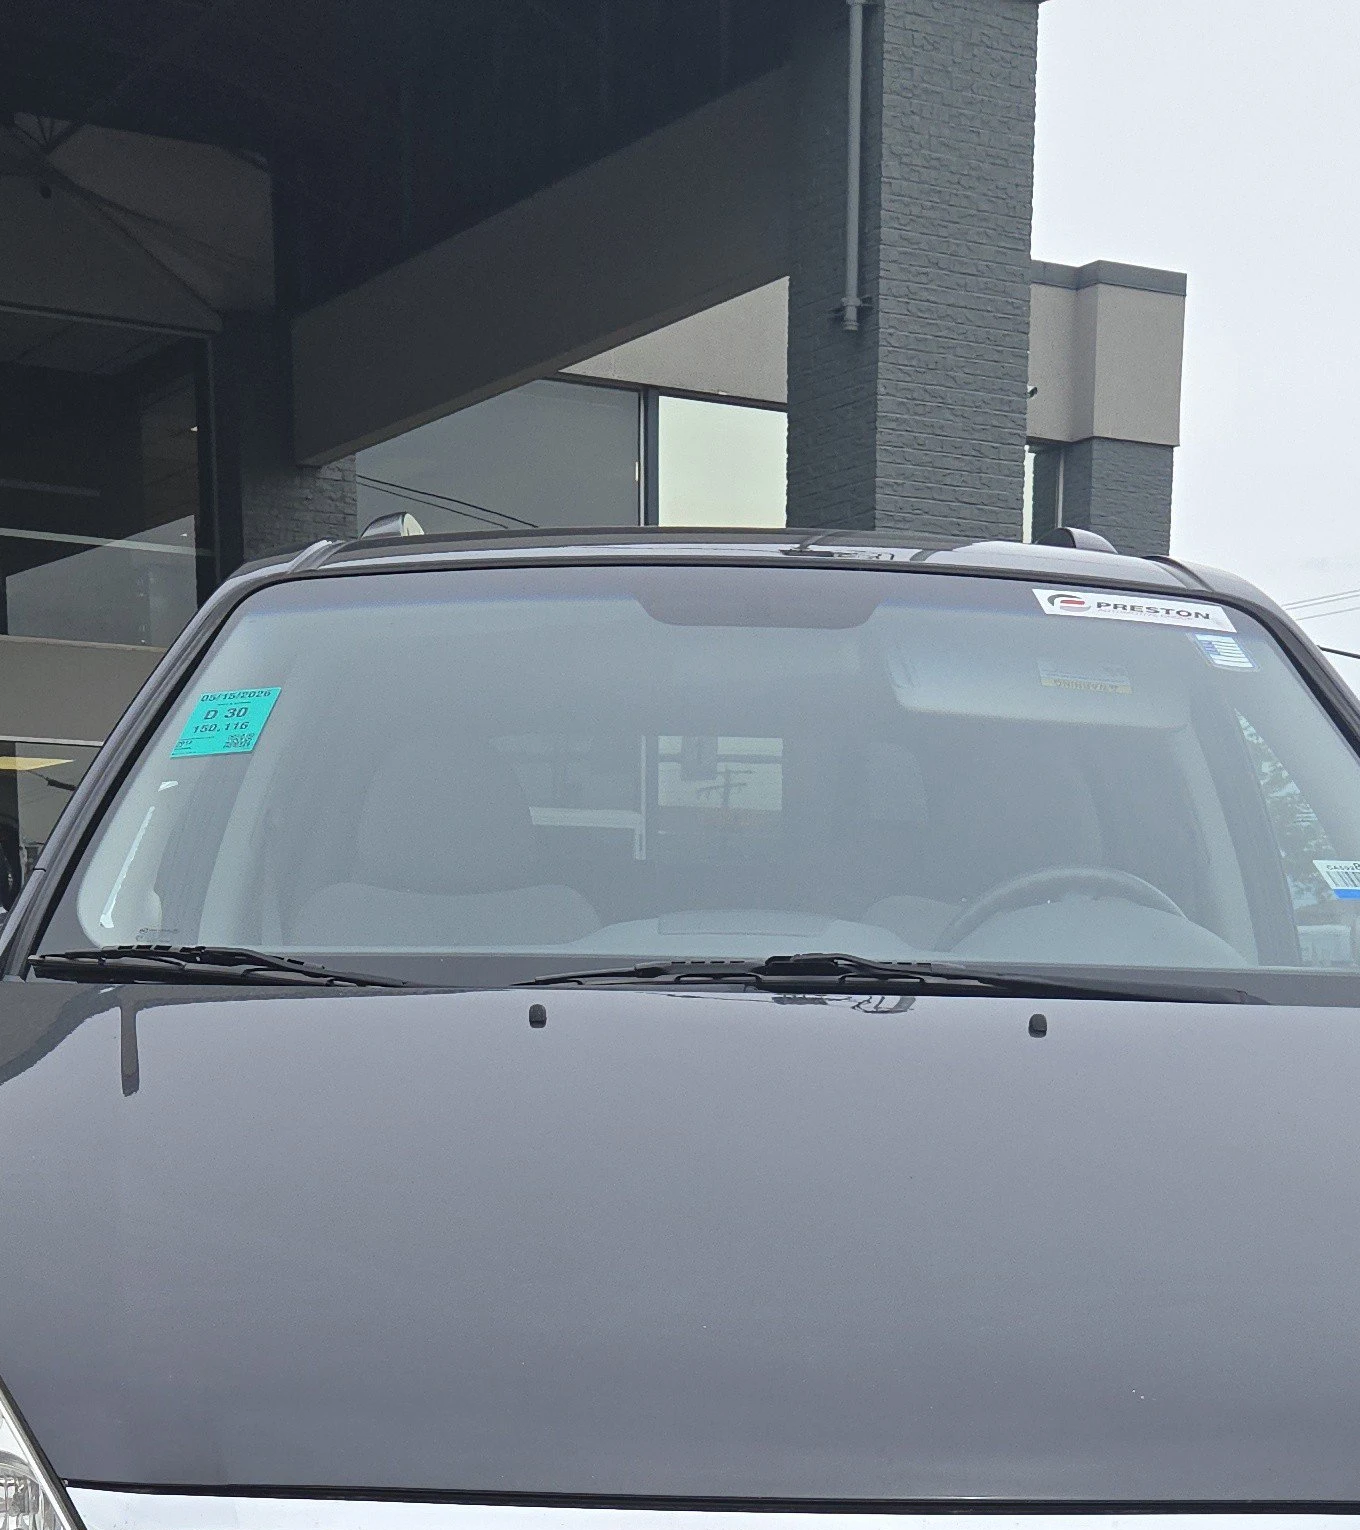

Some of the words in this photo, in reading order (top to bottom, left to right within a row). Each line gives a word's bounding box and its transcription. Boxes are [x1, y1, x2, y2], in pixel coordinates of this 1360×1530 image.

[1096, 601, 1210, 619] PRESTON
[203, 709, 218, 720] D
[224, 707, 249, 719] 30
